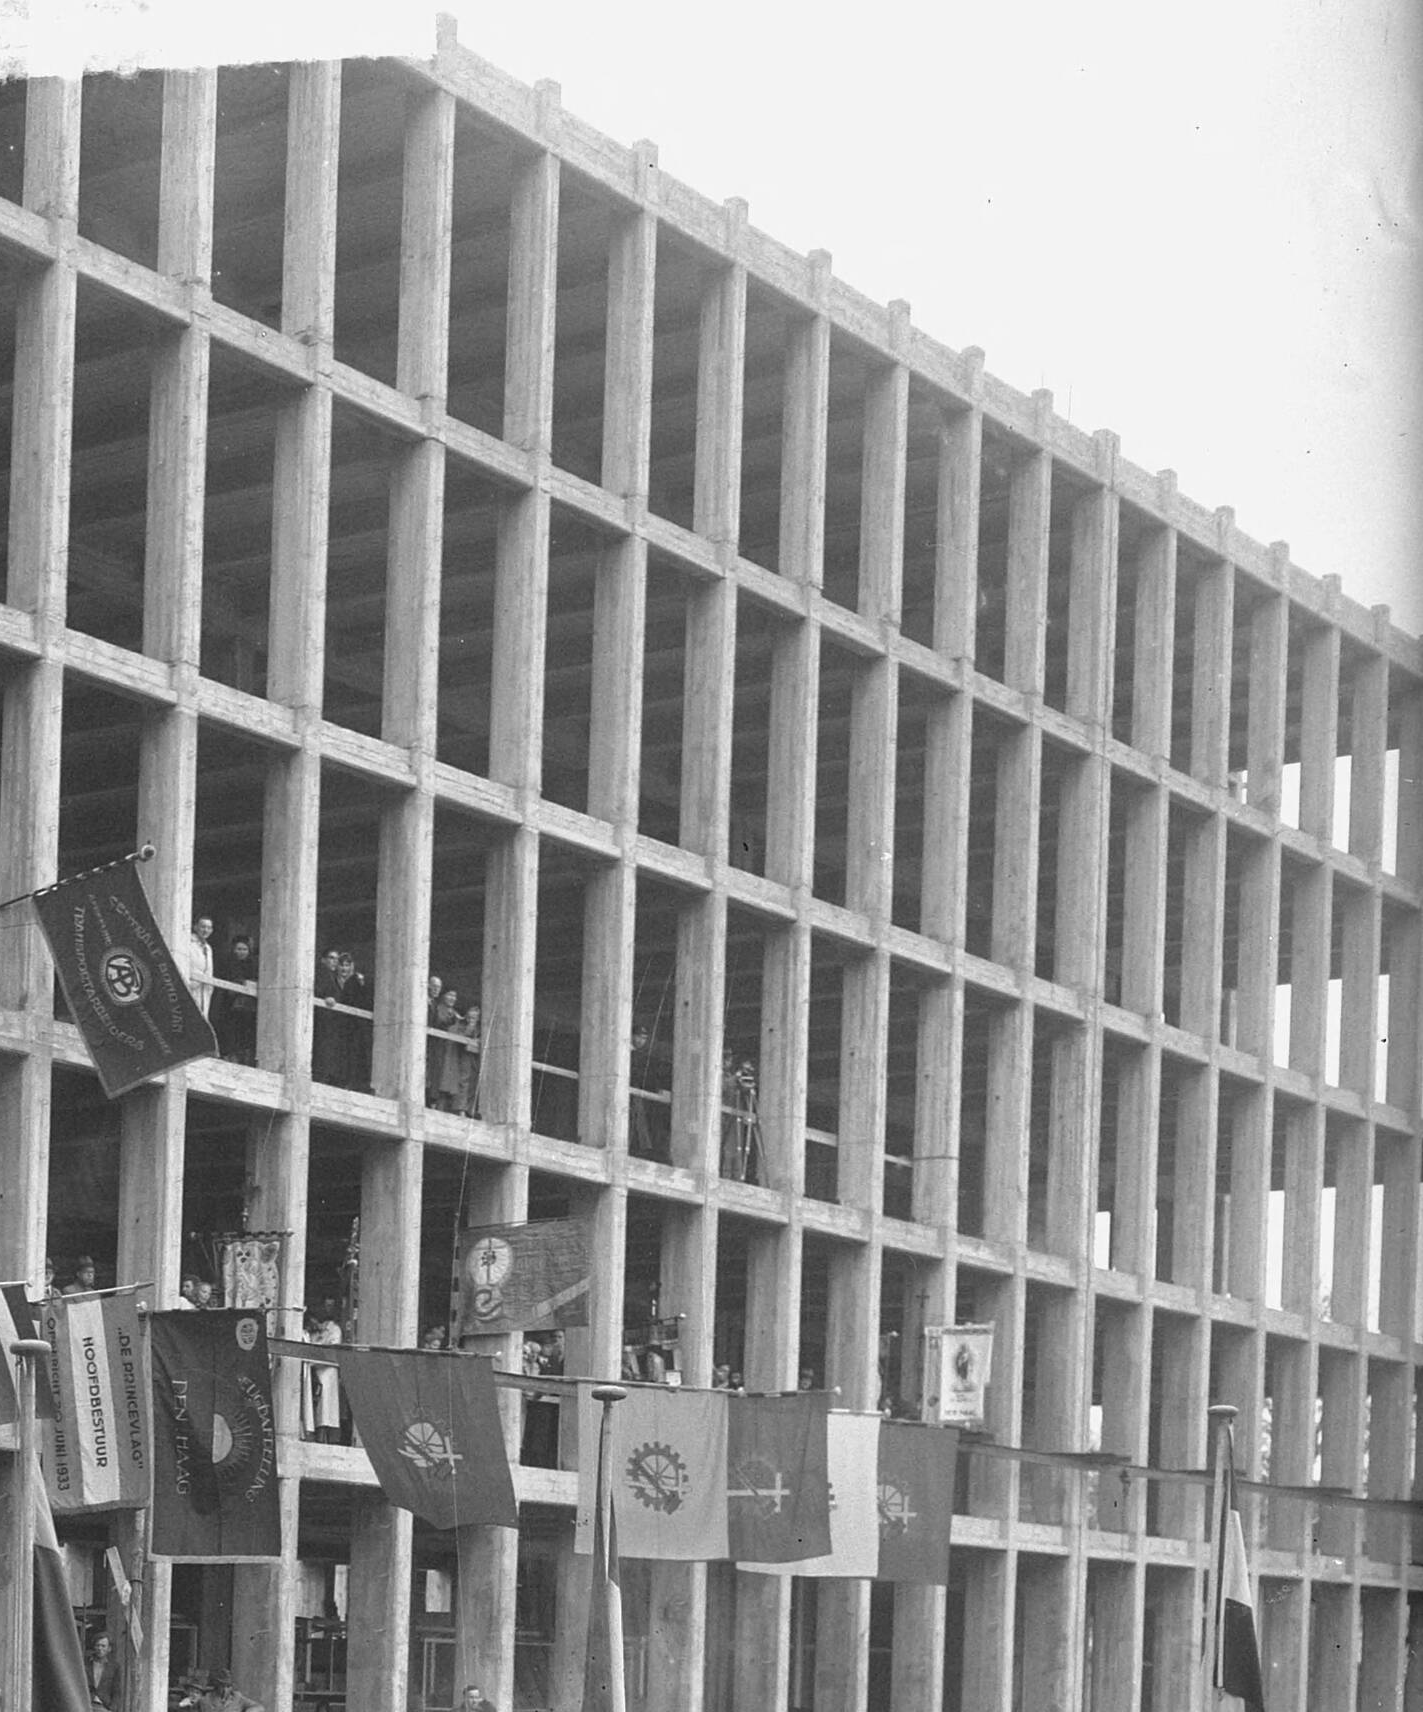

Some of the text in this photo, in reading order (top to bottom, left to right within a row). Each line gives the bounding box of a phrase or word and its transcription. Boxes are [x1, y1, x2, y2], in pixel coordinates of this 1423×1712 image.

[82, 1336, 108, 1468] HOOFDBESTUUR
[171, 1379, 190, 1495] DEN HAAG
[55, 1428, 66, 1462] JUNI
[57, 1462, 69, 1492] 1933
